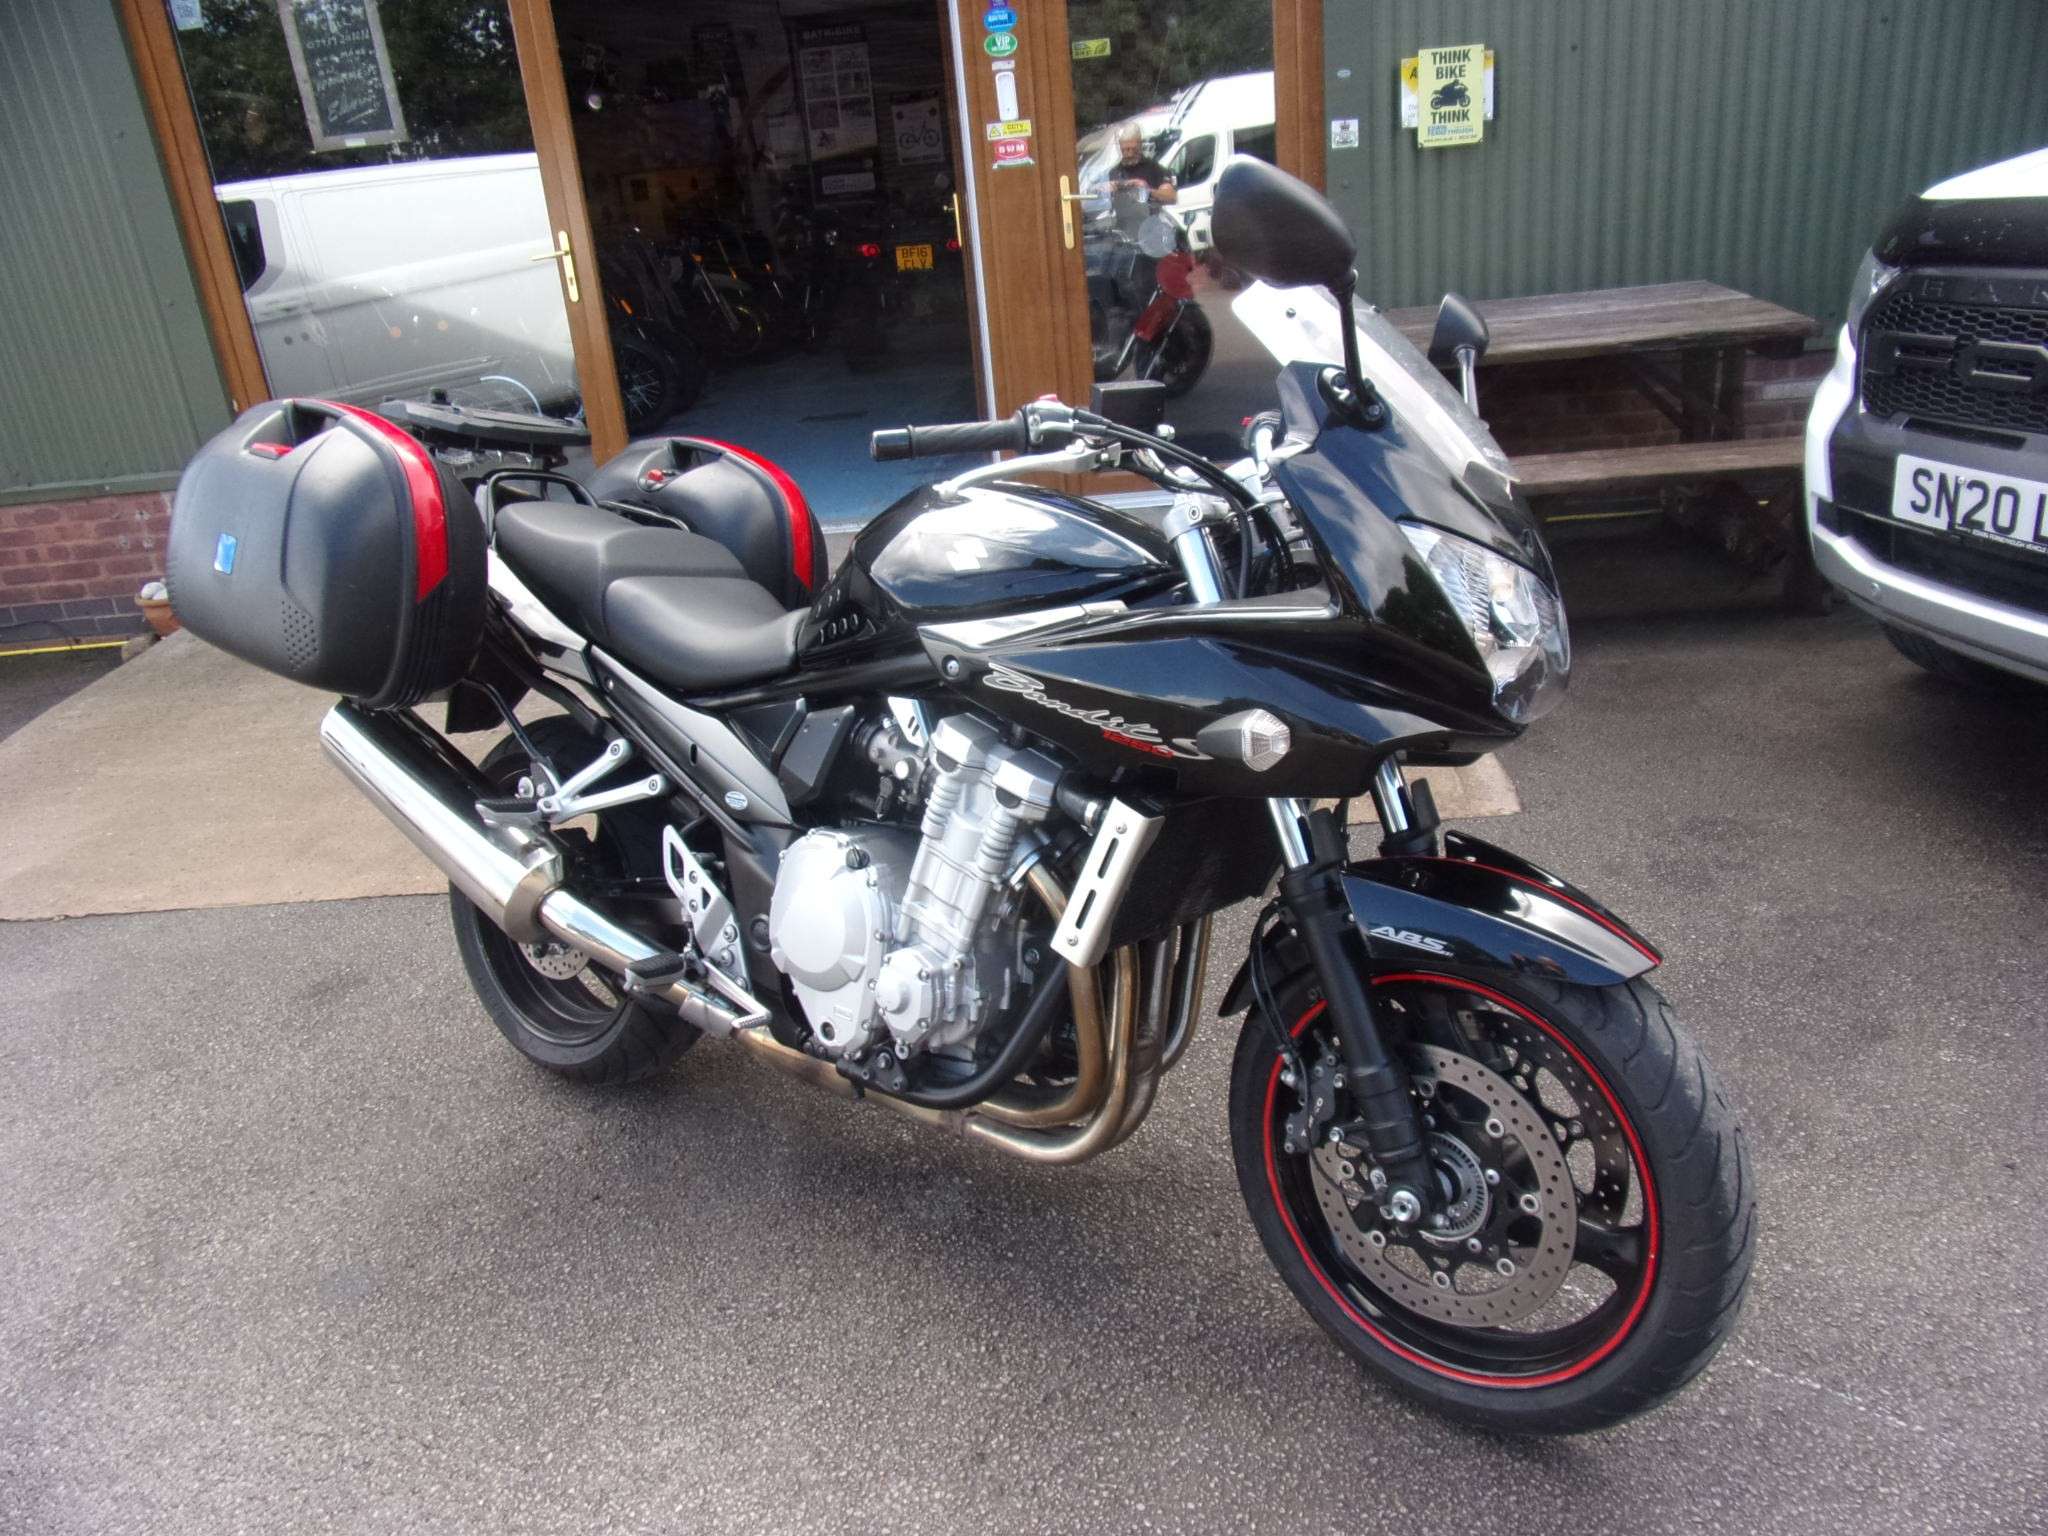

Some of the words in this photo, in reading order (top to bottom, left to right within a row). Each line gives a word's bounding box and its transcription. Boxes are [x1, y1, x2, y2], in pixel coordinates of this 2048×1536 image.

[1431, 49, 1471, 64] THINK
[1435, 64, 1467, 80] BIKE
[1431, 109, 1470, 124] THINK
[902, 247, 928, 258] BF16
[1910, 467, 2020, 535] SN20
[982, 662, 1163, 743] Bandit
[1369, 926, 1449, 952] ABS
